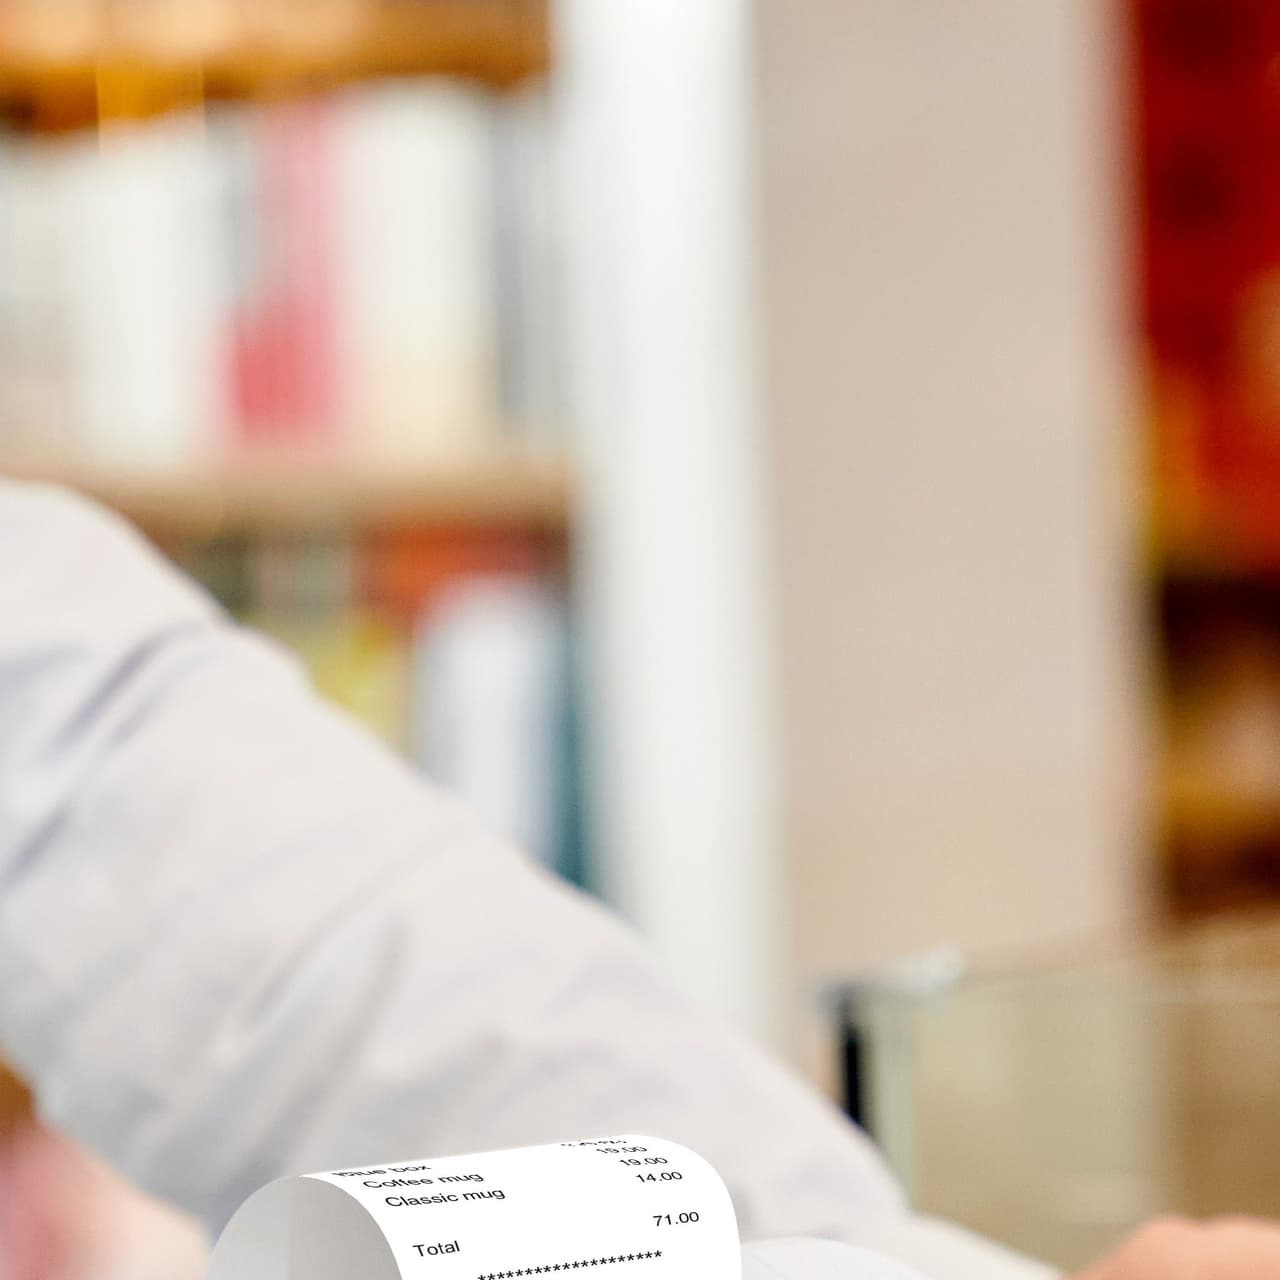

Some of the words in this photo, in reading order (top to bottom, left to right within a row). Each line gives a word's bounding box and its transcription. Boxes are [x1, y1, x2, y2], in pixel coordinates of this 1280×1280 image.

[596, 1146, 648, 1155] 19.00
[363, 1176, 434, 1189] Coffee
[437, 1173, 485, 1184] mug
[619, 1156, 669, 1167] 19.00
[385, 1192, 459, 1207] Classic
[462, 1189, 506, 1201] mug
[636, 1171, 683, 1183] 14.00
[412, 1239, 461, 1257] Total
[653, 1211, 700, 1227] 71.00
